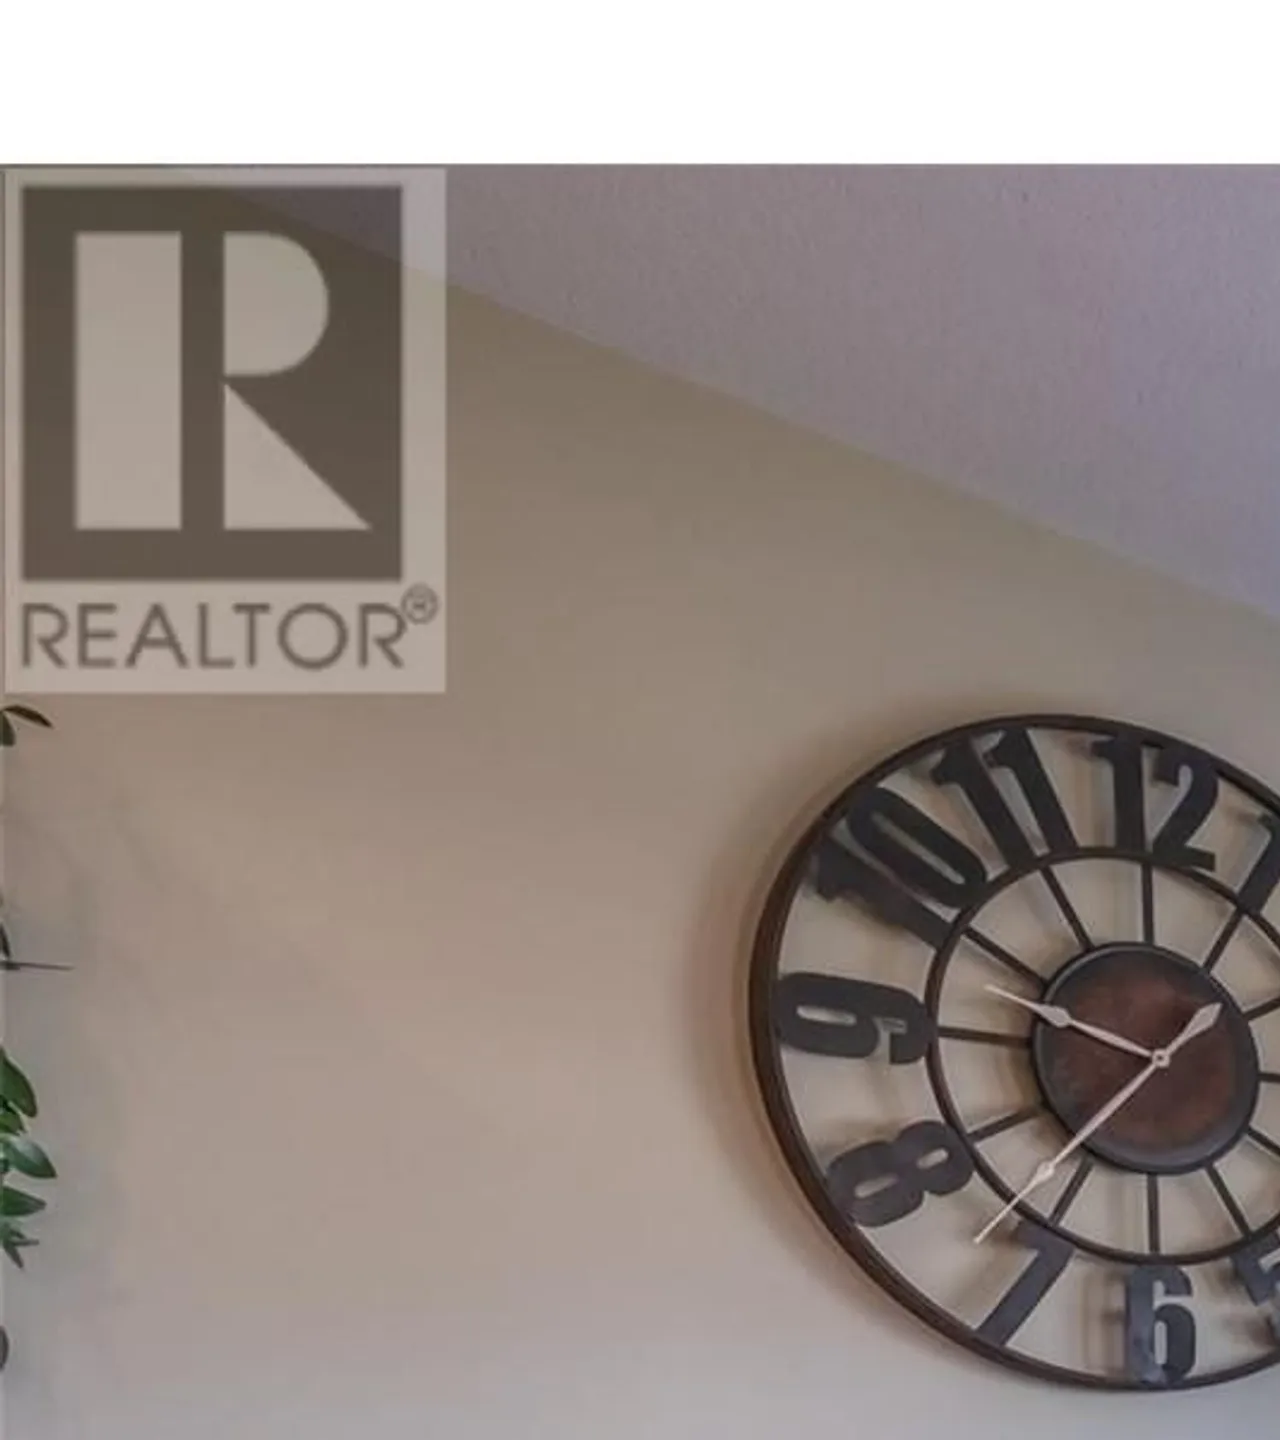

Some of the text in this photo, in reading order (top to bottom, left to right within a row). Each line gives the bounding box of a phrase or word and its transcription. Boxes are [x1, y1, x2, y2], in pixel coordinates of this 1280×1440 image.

[931, 727, 1079, 870] 11
[1090, 731, 1218, 873] 12
[815, 787, 986, 950] 10
[772, 971, 930, 1066] 9
[827, 1119, 975, 1228] 8
[972, 1219, 1076, 1348] 7
[1124, 1261, 1197, 1384] 6
